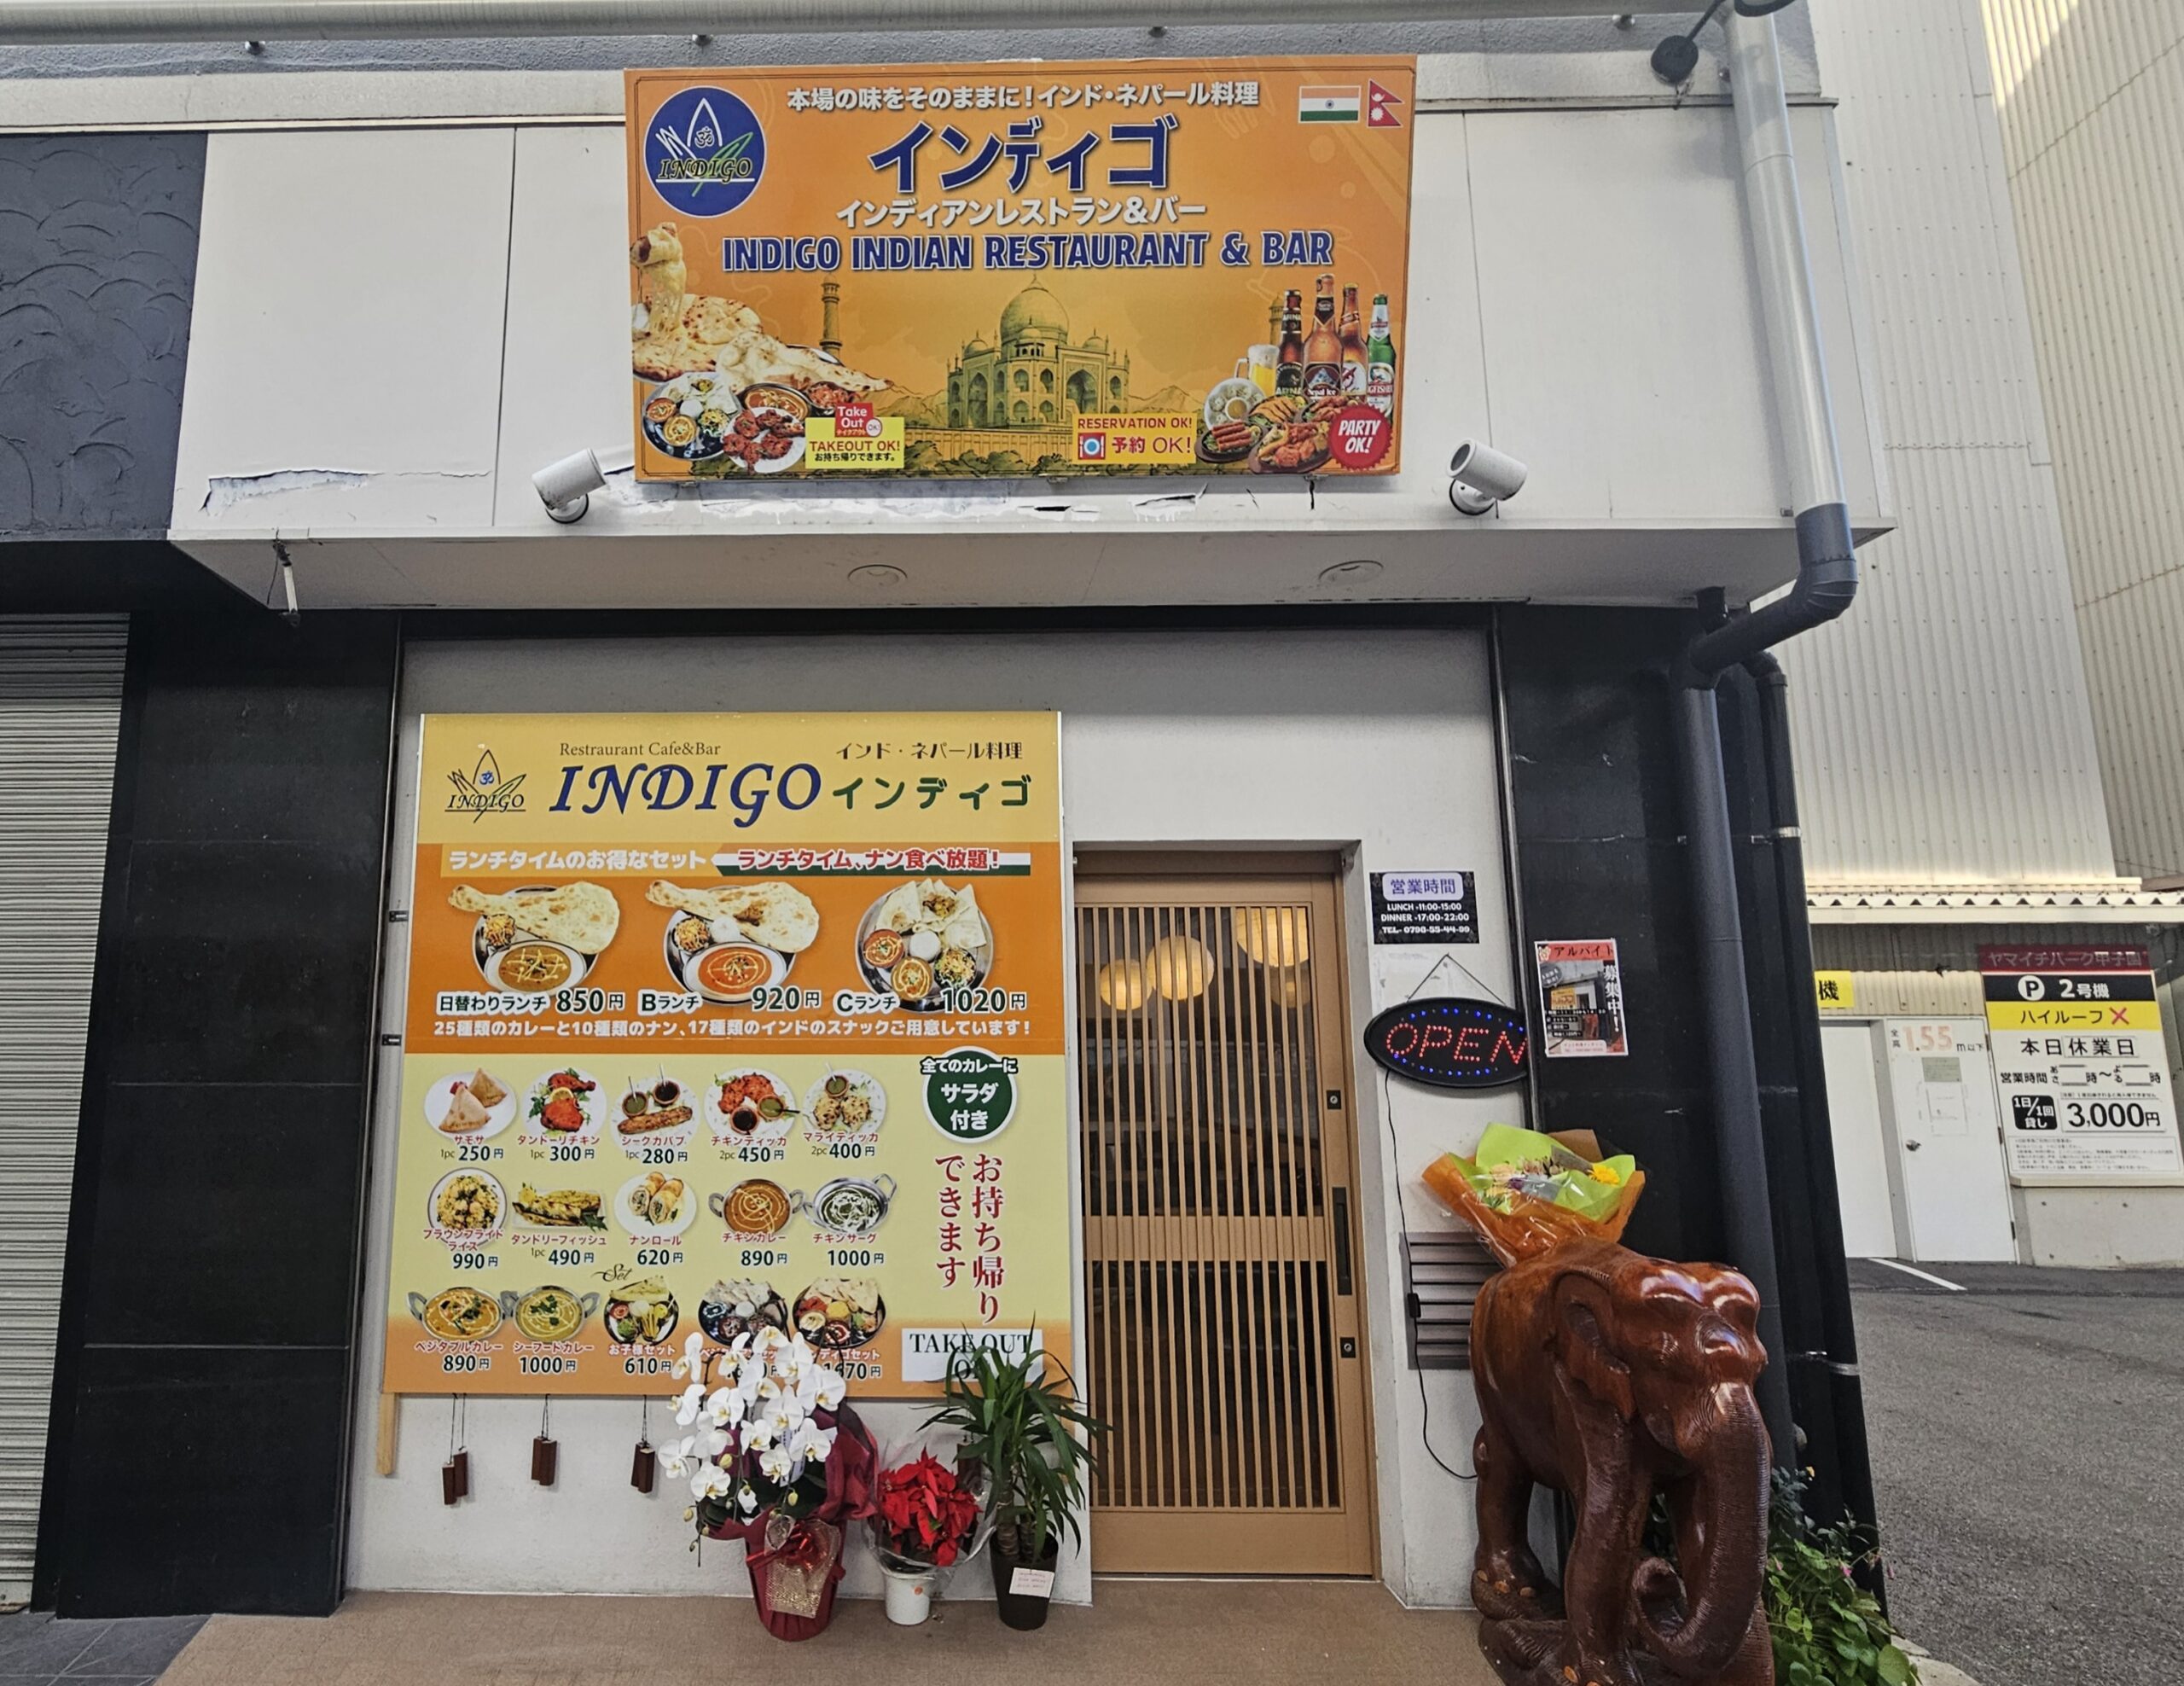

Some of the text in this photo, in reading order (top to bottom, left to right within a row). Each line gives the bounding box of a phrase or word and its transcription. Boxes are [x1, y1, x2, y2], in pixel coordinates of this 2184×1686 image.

[868, 113, 1179, 194] インディゴ
[658, 157, 753, 183] INDIGO
[836, 196, 1206, 228] インディアンレストラン&バー
[722, 230, 1333, 272] INDIGO INDIAN RESTAURANT & BAR
[838, 405, 868, 416] Take
[840, 417, 864, 428] Out
[1077, 417, 1193, 428] RESERVATION OK!
[1338, 420, 1381, 436] PARTY
[810, 440, 900, 451] TAKEOUT OK!
[1112, 436, 1191, 454] 予約 OK!
[1345, 437, 1373, 454] OK!
[648, 741, 722, 756] Cafe&Bar
[835, 741, 1024, 760] インド・ネパール料理
[548, 762, 822, 828] INDIGO
[832, 773, 1032, 811] インディゴ
[447, 794, 525, 812] INDIGO
[449, 849, 706, 871] ランチタイムのお得なセット
[1390, 877, 1457, 895] 営業時間
[1387, 902, 1414, 911] LUNCH
[1380, 913, 1413, 922] DINNER
[1554, 944, 1614, 956] アルバイト
[2059, 979, 2111, 999] 2号機
[439, 990, 624, 1013] 日替わりランチ 850円
[641, 986, 821, 1013] Bランチ 920円
[836, 988, 1026, 1013] Cランチ 1020円
[2020, 1010, 2103, 1025] ハイルーフ
[1385, 1022, 1528, 1066] OPEN
[1902, 1025, 1953, 1052] 1.55
[2020, 1038, 2135, 1056] 本日休業日
[921, 1057, 1017, 1073] 全てのカレーに
[2001, 1072, 2048, 1084] 営業時間
[940, 1082, 999, 1104] サラダ
[950, 1109, 989, 1131] 付き
[2067, 1102, 2161, 1128] 3,000円
[454, 1135, 485, 1145] サモサ
[517, 1135, 601, 1145] タンドーリチキン
[711, 1136, 787, 1147] チキンティッカ
[803, 1131, 880, 1143] マライティッカ
[440, 1145, 504, 1161] 1pc 250円
[530, 1146, 595, 1161] 1pc 300円
[624, 1148, 688, 1164] 1pc 280円
[719, 1147, 784, 1162] 2pc 450円
[811, 1142, 875, 1159] 2pc 400円
[935, 1154, 966, 1288] できます
[449, 1241, 478, 1251] ライス
[512, 1234, 607, 1245] タンドリーフィッシュ
[629, 1235, 682, 1246] ナンロール
[723, 1232, 787, 1243] チキンカレー
[813, 1233, 877, 1243] チキンサーグ
[971, 1153, 1005, 1324] お持ち帰り
[452, 1253, 499, 1269] 990円
[531, 1247, 595, 1265] 1pc 490円
[636, 1249, 683, 1264] 620円
[741, 1249, 787, 1266] 890円
[828, 1249, 885, 1266] 1000円
[590, 1263, 633, 1282] Set
[513, 1343, 595, 1354] シーフードカレー
[909, 1333, 1031, 1354] TAKE OUT
[443, 1354, 490, 1372] 890円
[519, 1357, 577, 1374] 1000円
[624, 1358, 671, 1375] 610円
